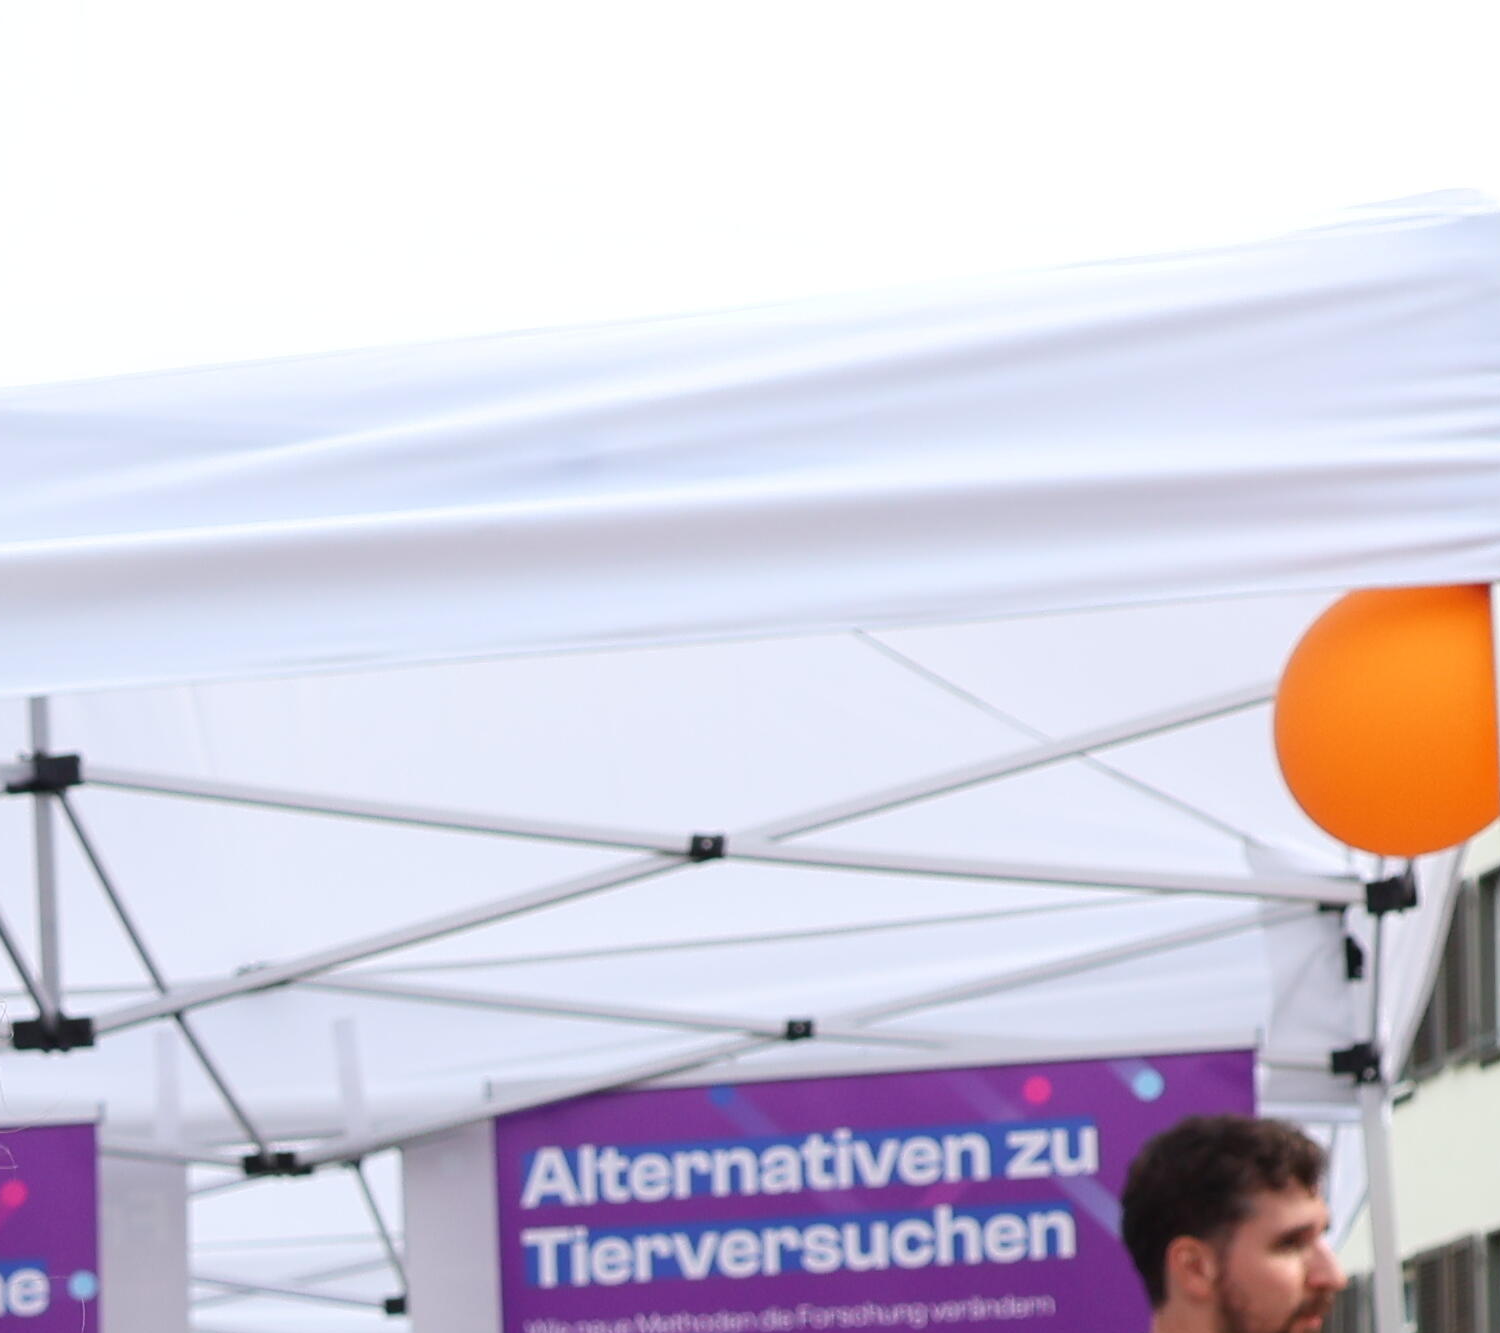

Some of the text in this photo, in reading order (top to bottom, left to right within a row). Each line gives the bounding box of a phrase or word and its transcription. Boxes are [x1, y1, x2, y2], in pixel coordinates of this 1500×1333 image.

[520, 1124, 1099, 1208] Alternativen zu
[520, 1204, 1077, 1289] Tierversuchen
[760, 1306, 795, 1333] die
[796, 1300, 928, 1333] Forschung
[931, 1294, 1056, 1327] verändern
